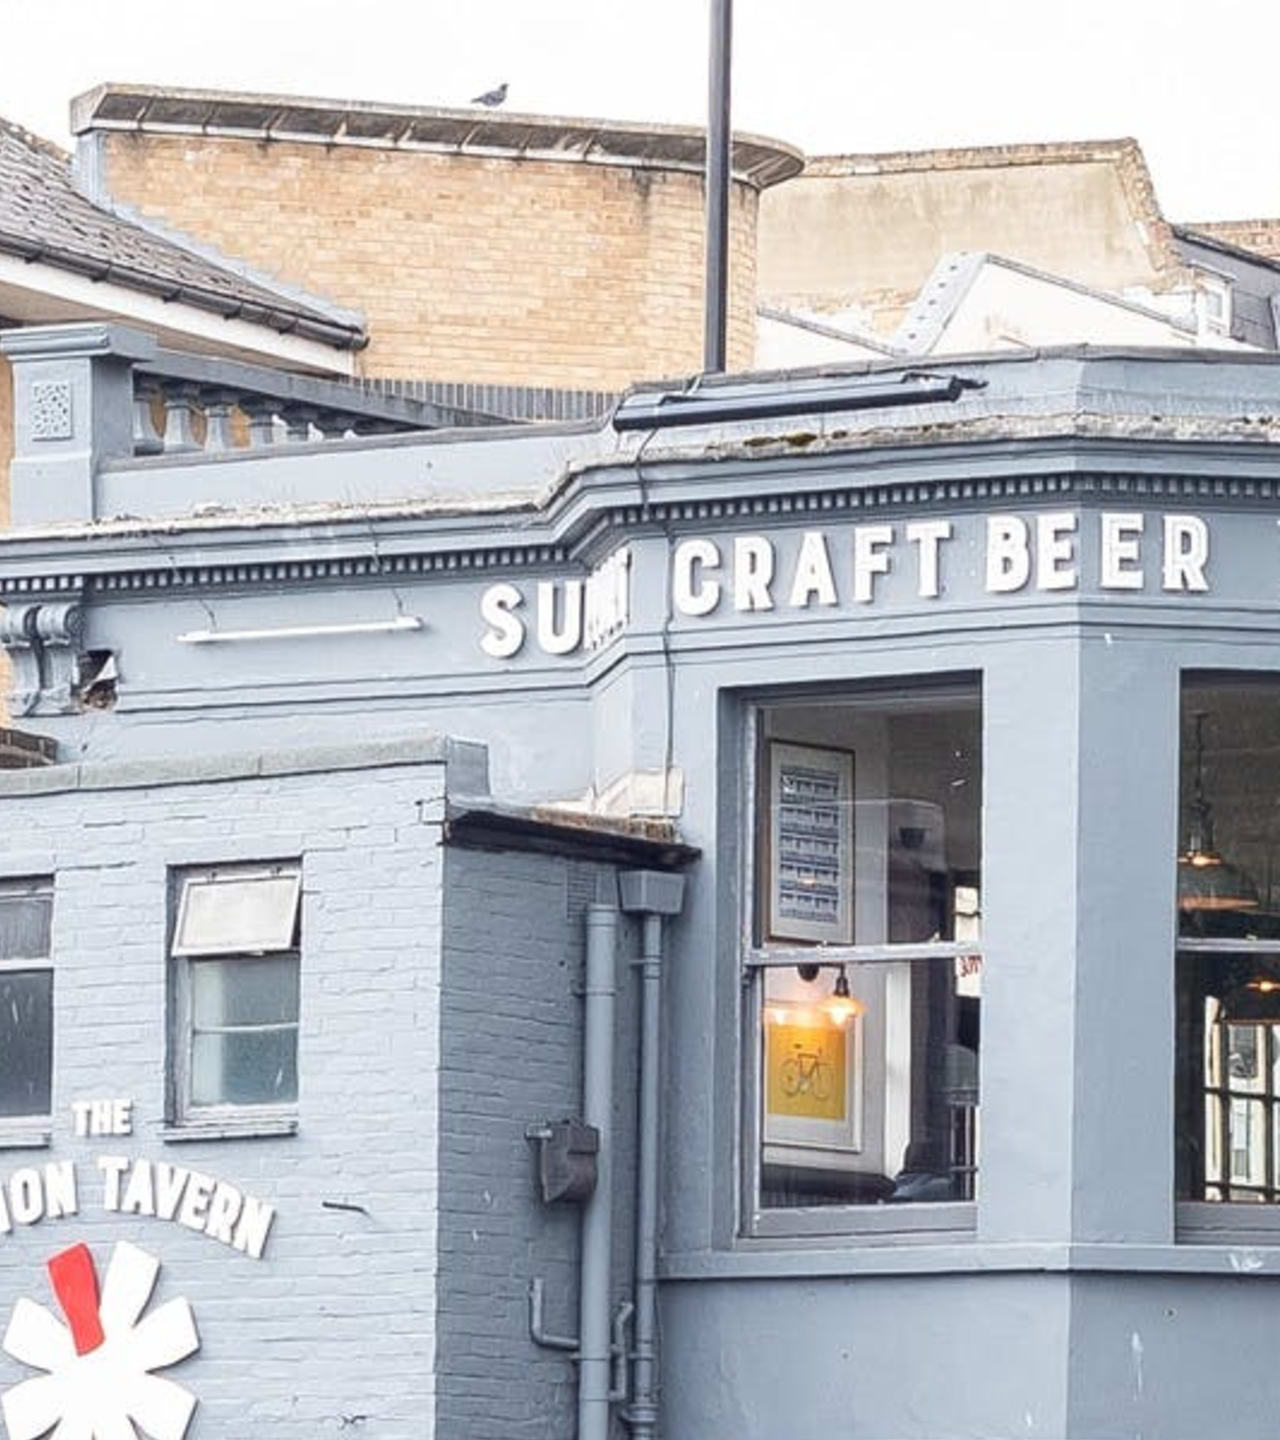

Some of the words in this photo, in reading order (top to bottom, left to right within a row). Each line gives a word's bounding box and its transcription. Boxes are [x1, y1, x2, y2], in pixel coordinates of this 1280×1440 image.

[673, 520, 952, 617] CRAFT
[985, 511, 1209, 592] BEER
[72, 1099, 133, 1136] THE
[97, 1155, 276, 1259] TAVERN
